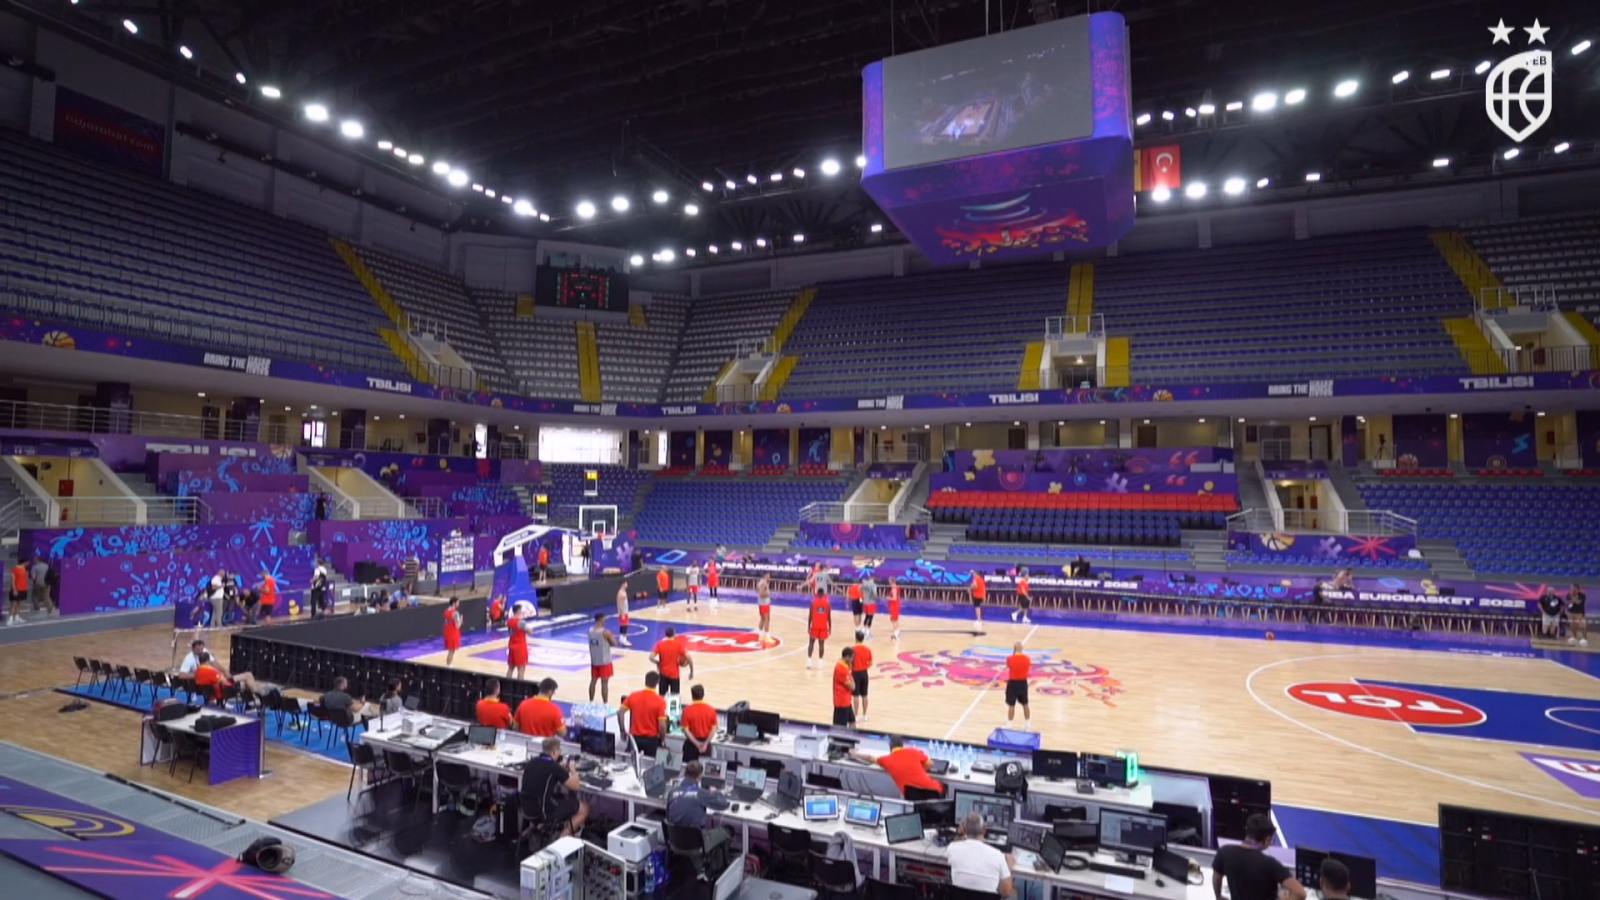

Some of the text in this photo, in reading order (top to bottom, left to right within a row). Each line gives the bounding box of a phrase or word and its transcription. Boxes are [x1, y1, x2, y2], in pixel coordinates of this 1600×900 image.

[203, 352, 230, 367] BRING
[231, 357, 246, 369] THE
[367, 377, 412, 393] TBILISI
[1268, 385, 1292, 395] BRING
[1293, 384, 1308, 394] THE
[1459, 376, 1534, 390] TBILISI
[989, 393, 1039, 404] TBILISI
[661, 405, 696, 415] TBILISI
[722, 562, 743, 570] FIBA
[745, 562, 812, 573] EUROBASKET
[985, 575, 1011, 583] FIBA
[1104, 580, 1138, 589] 2022
[1359, 592, 1474, 606] EUROBASKET
[1479, 598, 1526, 609] 2022
